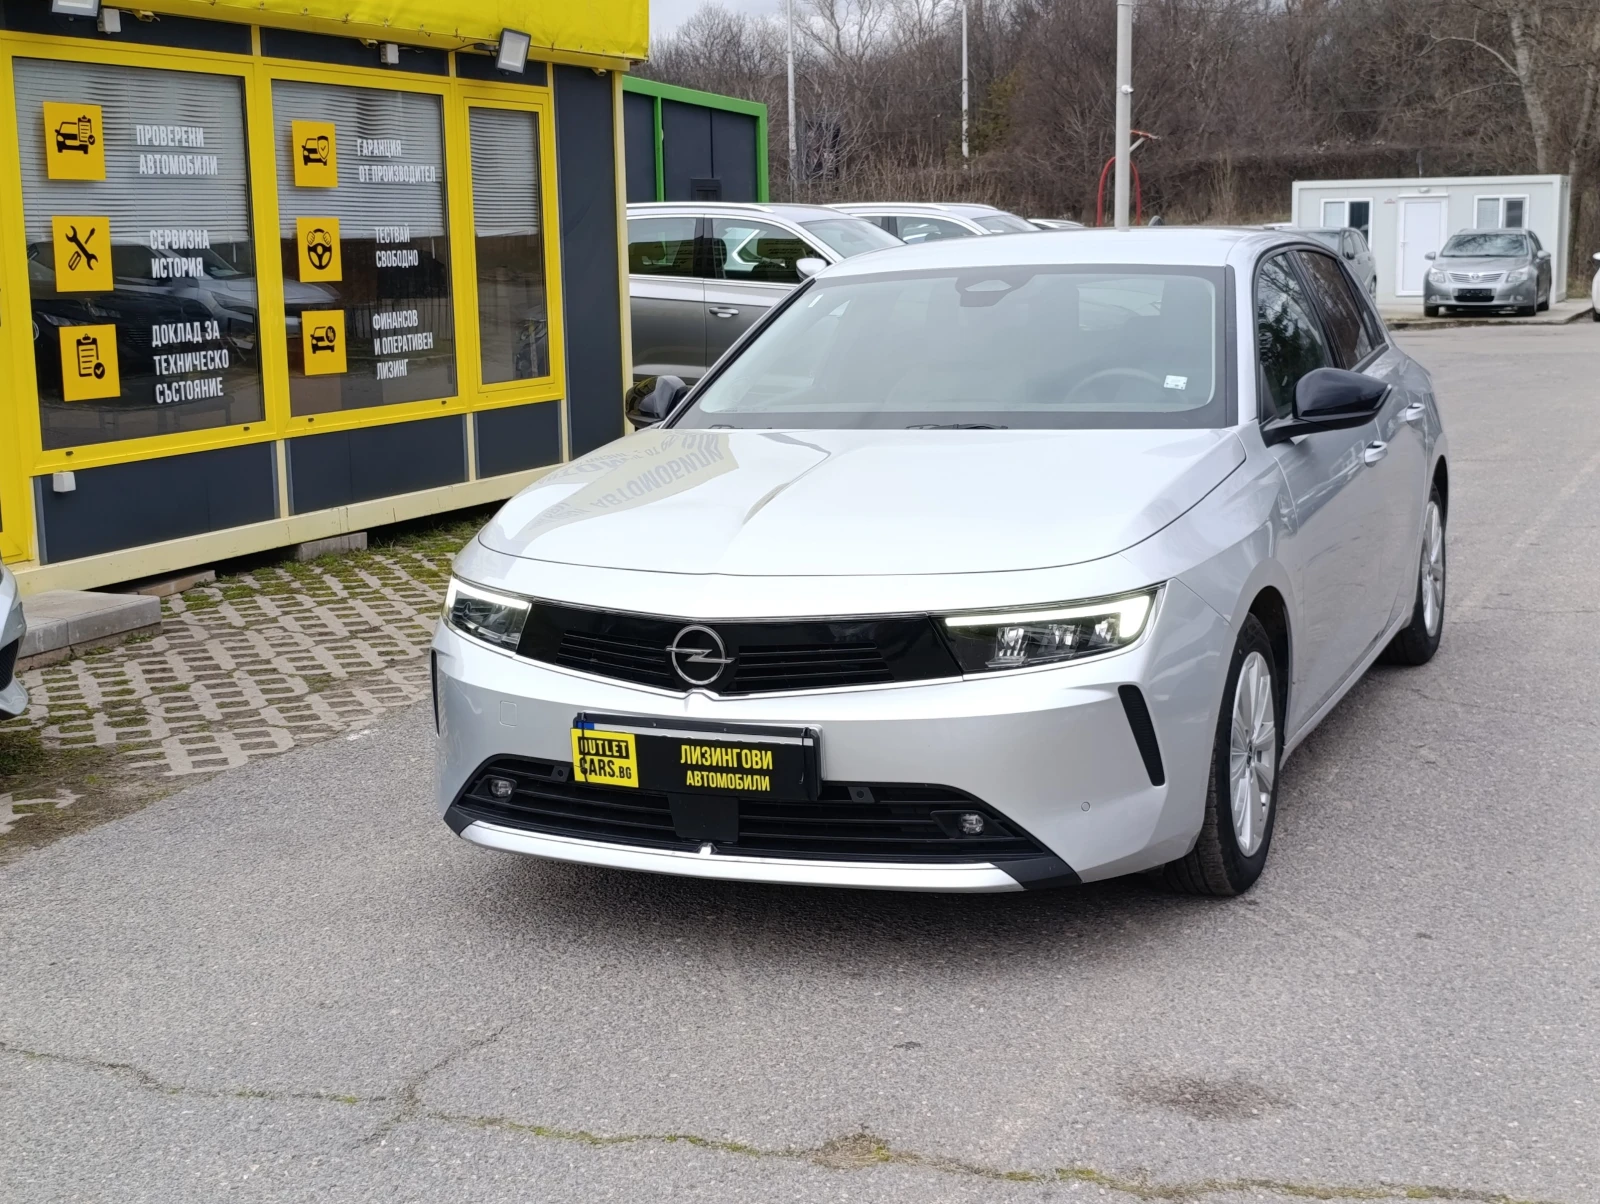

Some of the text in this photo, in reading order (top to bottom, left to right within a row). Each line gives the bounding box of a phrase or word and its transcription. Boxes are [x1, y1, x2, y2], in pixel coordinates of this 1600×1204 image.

[136, 125, 204, 147] ПРОВЕРЕНИ
[357, 139, 402, 158] ГАРАНЦИЯ
[140, 154, 218, 175] АВТОМОБИЛИ
[359, 165, 436, 184] ОТ ПРОИЗВОДИТЕЛ
[150, 229, 210, 249] СЕРВИЗНА
[375, 223, 410, 243] ТЕСТВАЙ
[151, 257, 204, 278] ИСТОРИЯ
[376, 249, 419, 268] СВОБОДНО
[372, 309, 419, 330] ФИНАНСОВ
[152, 320, 220, 347] ДОКЛАД ЗА
[374, 332, 434, 356] И ОПЕРАТИВЕН
[153, 349, 229, 375] ТЕХНИЧЕСКО
[376, 359, 408, 380] ЛИЗИНГ
[155, 377, 224, 404] СЪСТОЯНИЕ
[680, 745, 773, 770] ЛИЗИНГОВИ
[686, 770, 770, 791] АВТОМОБИЛИ
